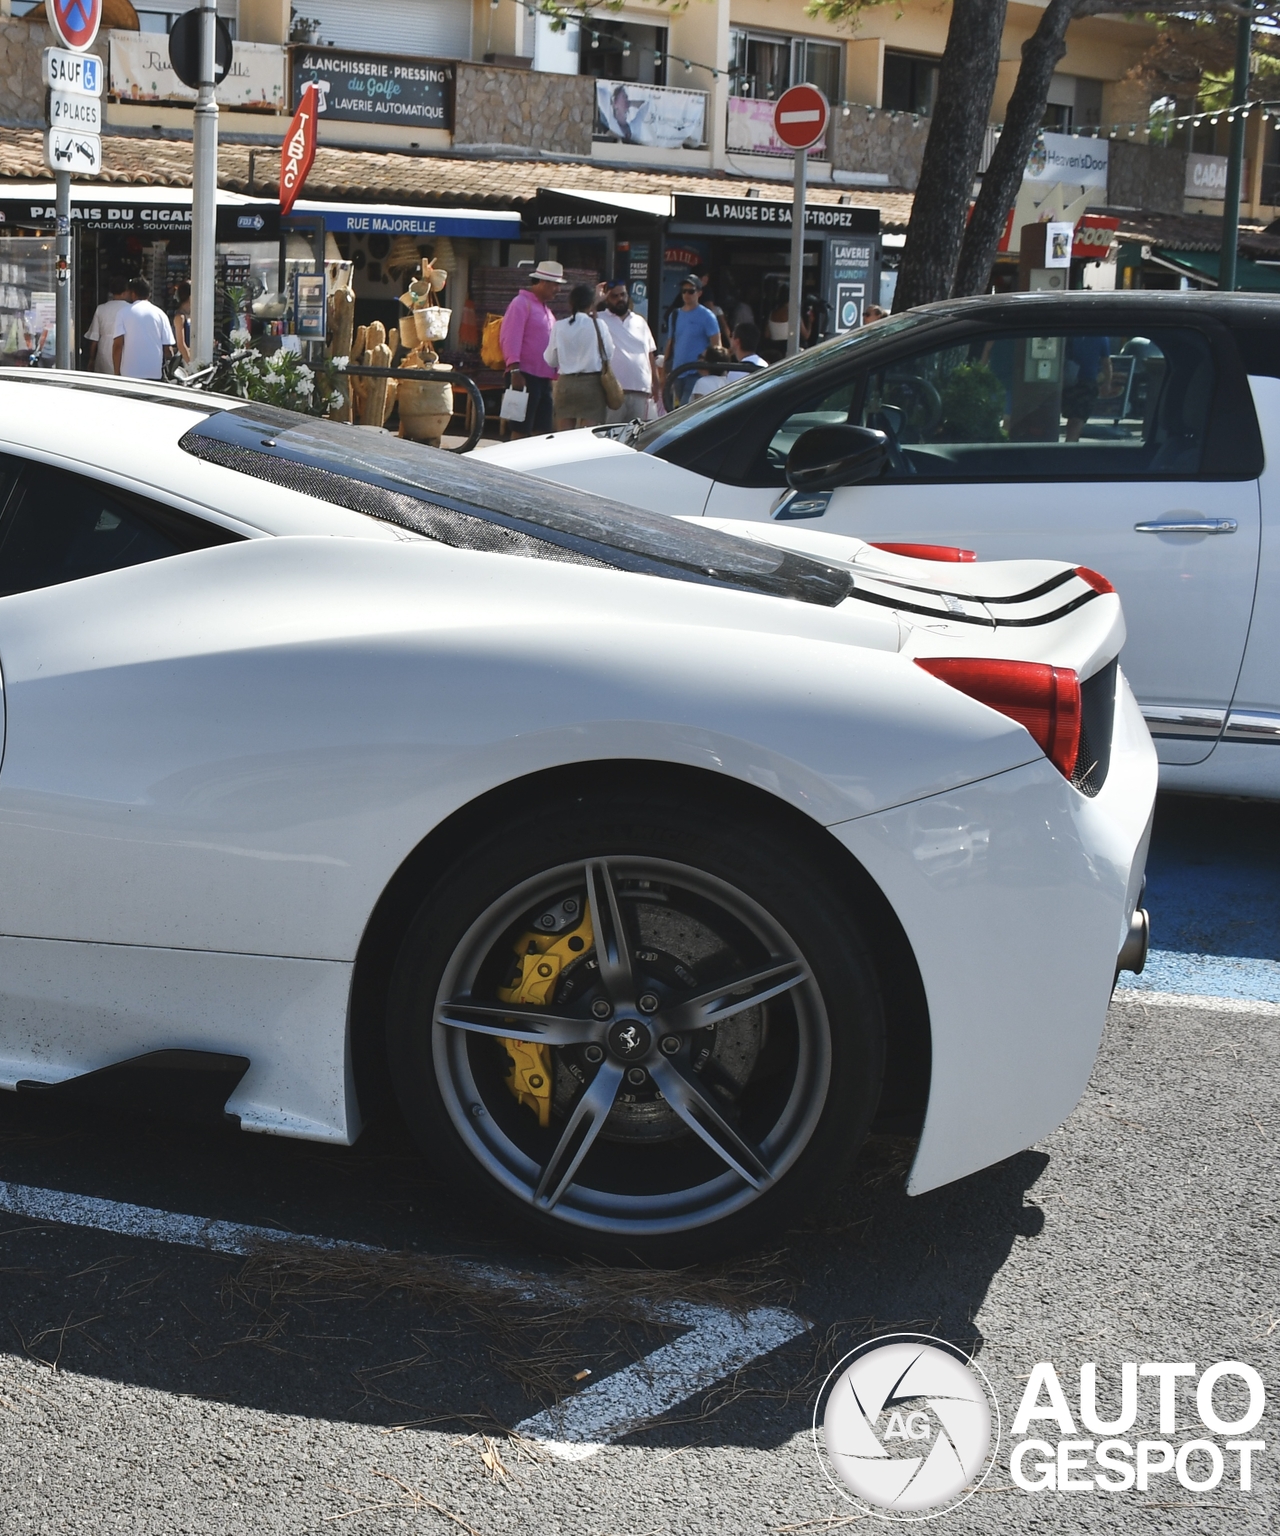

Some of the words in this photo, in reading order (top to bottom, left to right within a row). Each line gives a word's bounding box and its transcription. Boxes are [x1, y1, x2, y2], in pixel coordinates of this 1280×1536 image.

[51, 58, 81, 83] SAUF
[302, 57, 388, 77] BLANCHISSERIE
[394, 66, 444, 82] PRESSING
[348, 77, 365, 92] du
[367, 79, 401, 99] Golfe
[55, 101, 60, 117] 2
[63, 102, 96, 123] PLACES
[335, 97, 373, 112] LAVERIE
[375, 102, 444, 119] AUTOMATIQUE
[284, 113, 309, 188] TABAC
[30, 206, 102, 220] PAAIS
[108, 208, 134, 220] DU
[538, 215, 572, 226] LAVERIE
[576, 214, 618, 225] LAUNDRY
[706, 203, 720, 218] LA
[723, 204, 758, 220] PAUSE
[761, 207, 776, 221] DE
[778, 208, 852, 227] SAT-TROPEZ
[87, 222, 134, 230] CADEAUX
[347, 217, 370, 230] RUE
[373, 218, 436, 233] MAJORELLE
[835, 246, 870, 259] LAVERIE
[835, 258, 869, 267] AUTOMATIQUE
[834, 270, 868, 279] LAUNDRY
[632, 282, 647, 297] ICI
